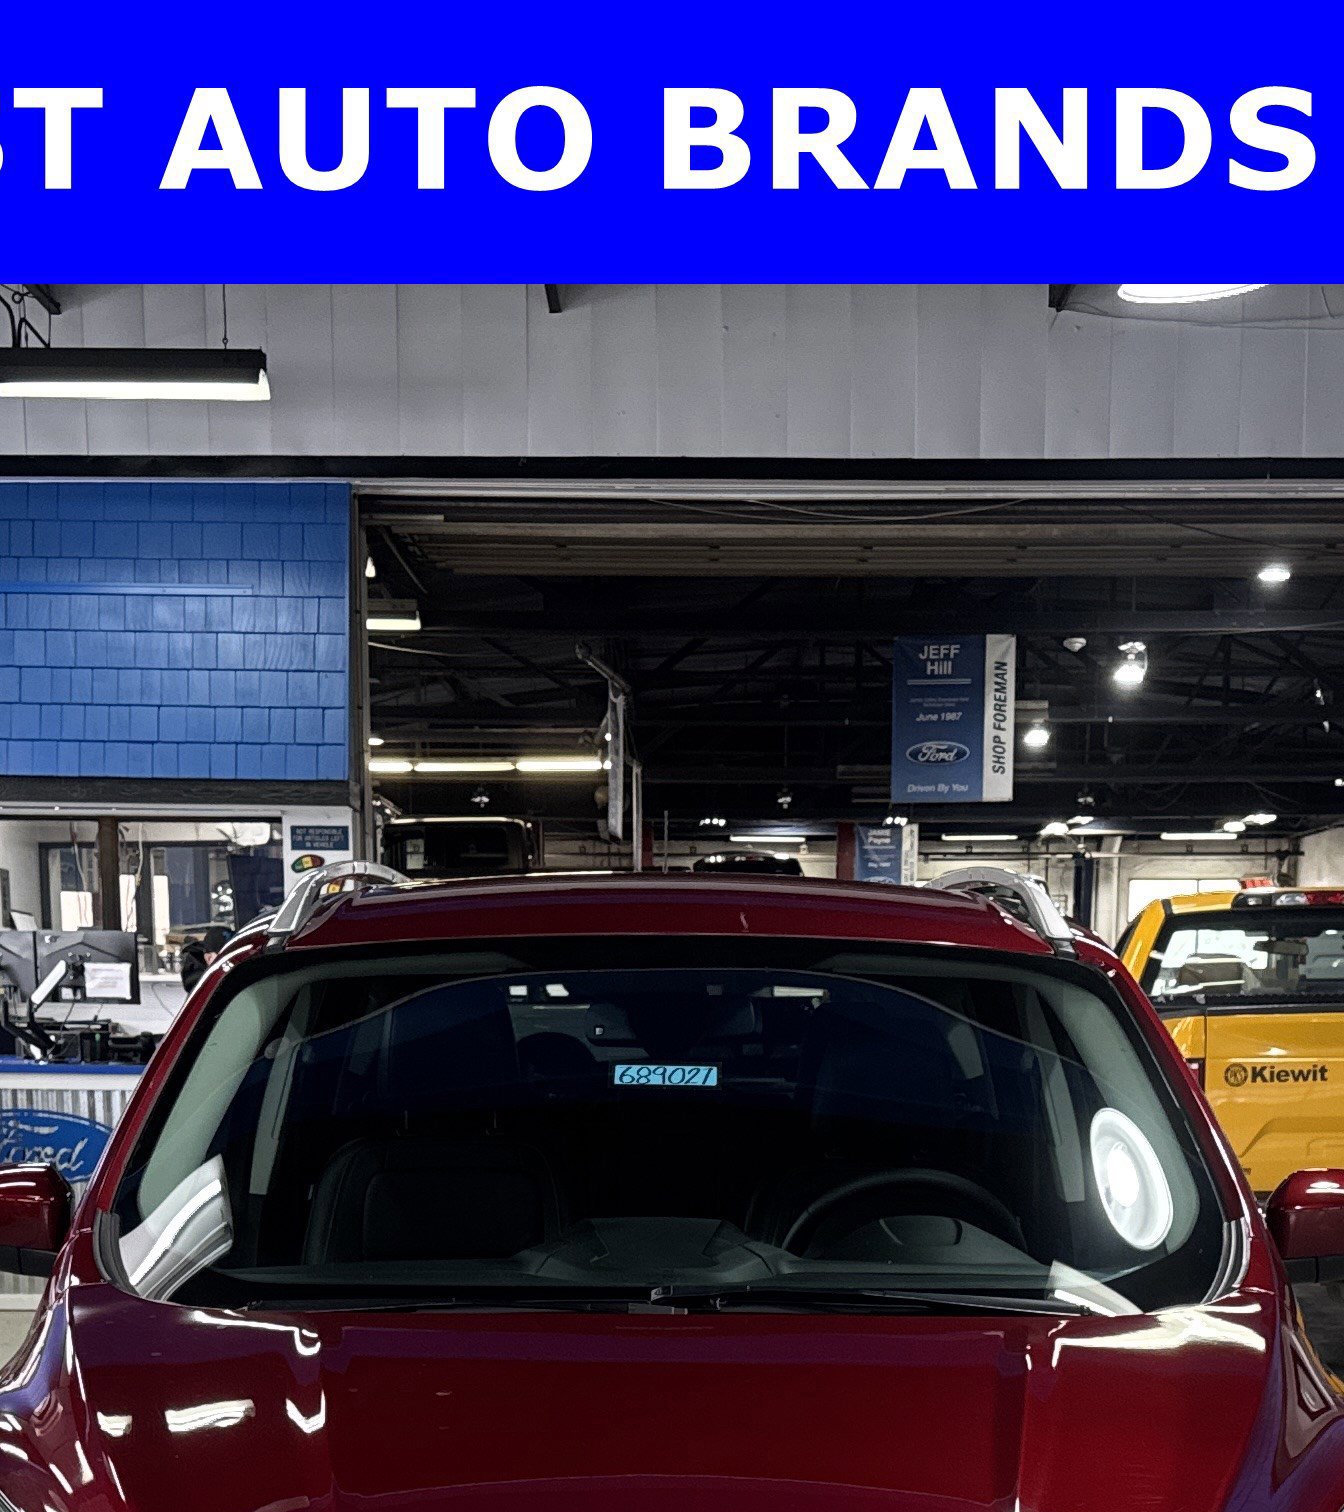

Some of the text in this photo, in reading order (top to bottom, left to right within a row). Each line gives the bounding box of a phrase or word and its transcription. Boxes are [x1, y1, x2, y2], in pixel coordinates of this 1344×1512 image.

[918, 644, 961, 659] JEFF
[926, 660, 953, 675] Hill
[992, 661, 1008, 775] SHOP FOREMAN
[917, 744, 958, 762] Ford
[1250, 1064, 1328, 1083] Kiewit
